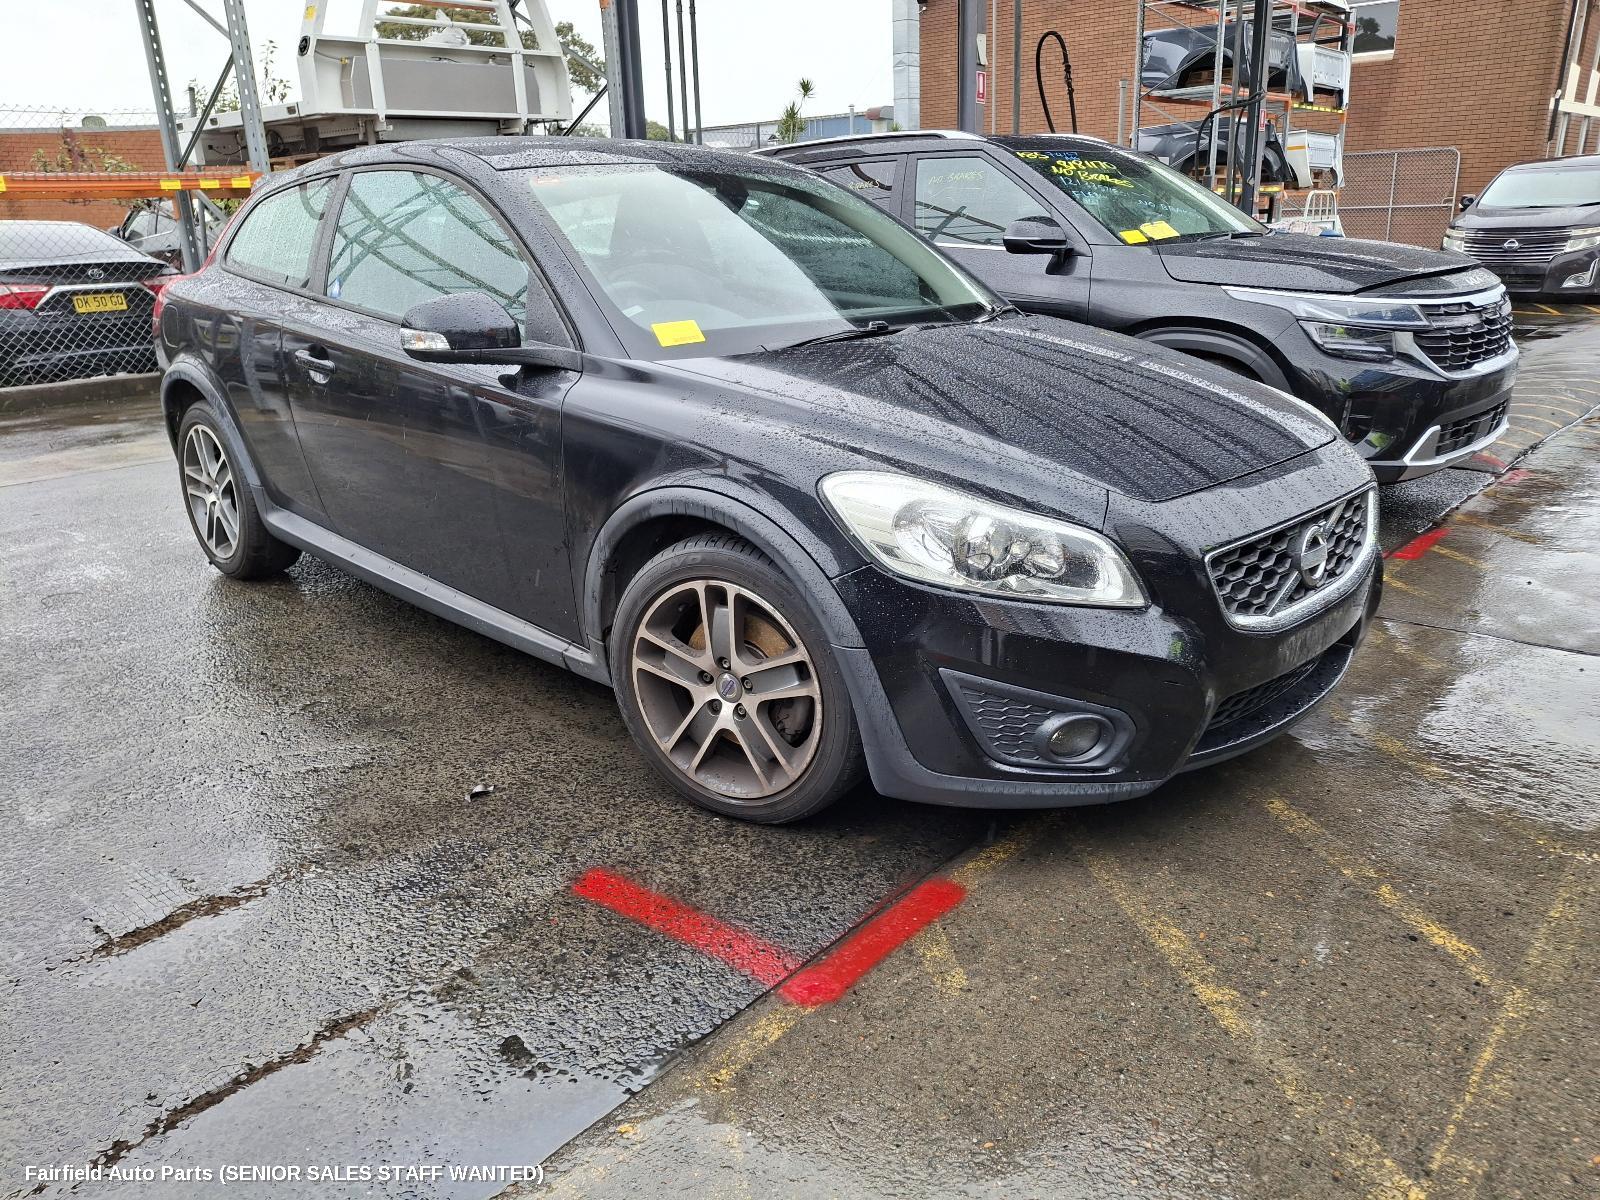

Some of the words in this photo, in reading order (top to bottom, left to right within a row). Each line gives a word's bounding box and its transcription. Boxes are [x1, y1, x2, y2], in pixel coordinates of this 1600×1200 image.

[1051, 165, 1074, 176] NO
[1078, 170, 1134, 188] BRAKES
[76, 297, 91, 309] DK
[92, 295, 107, 308] 50
